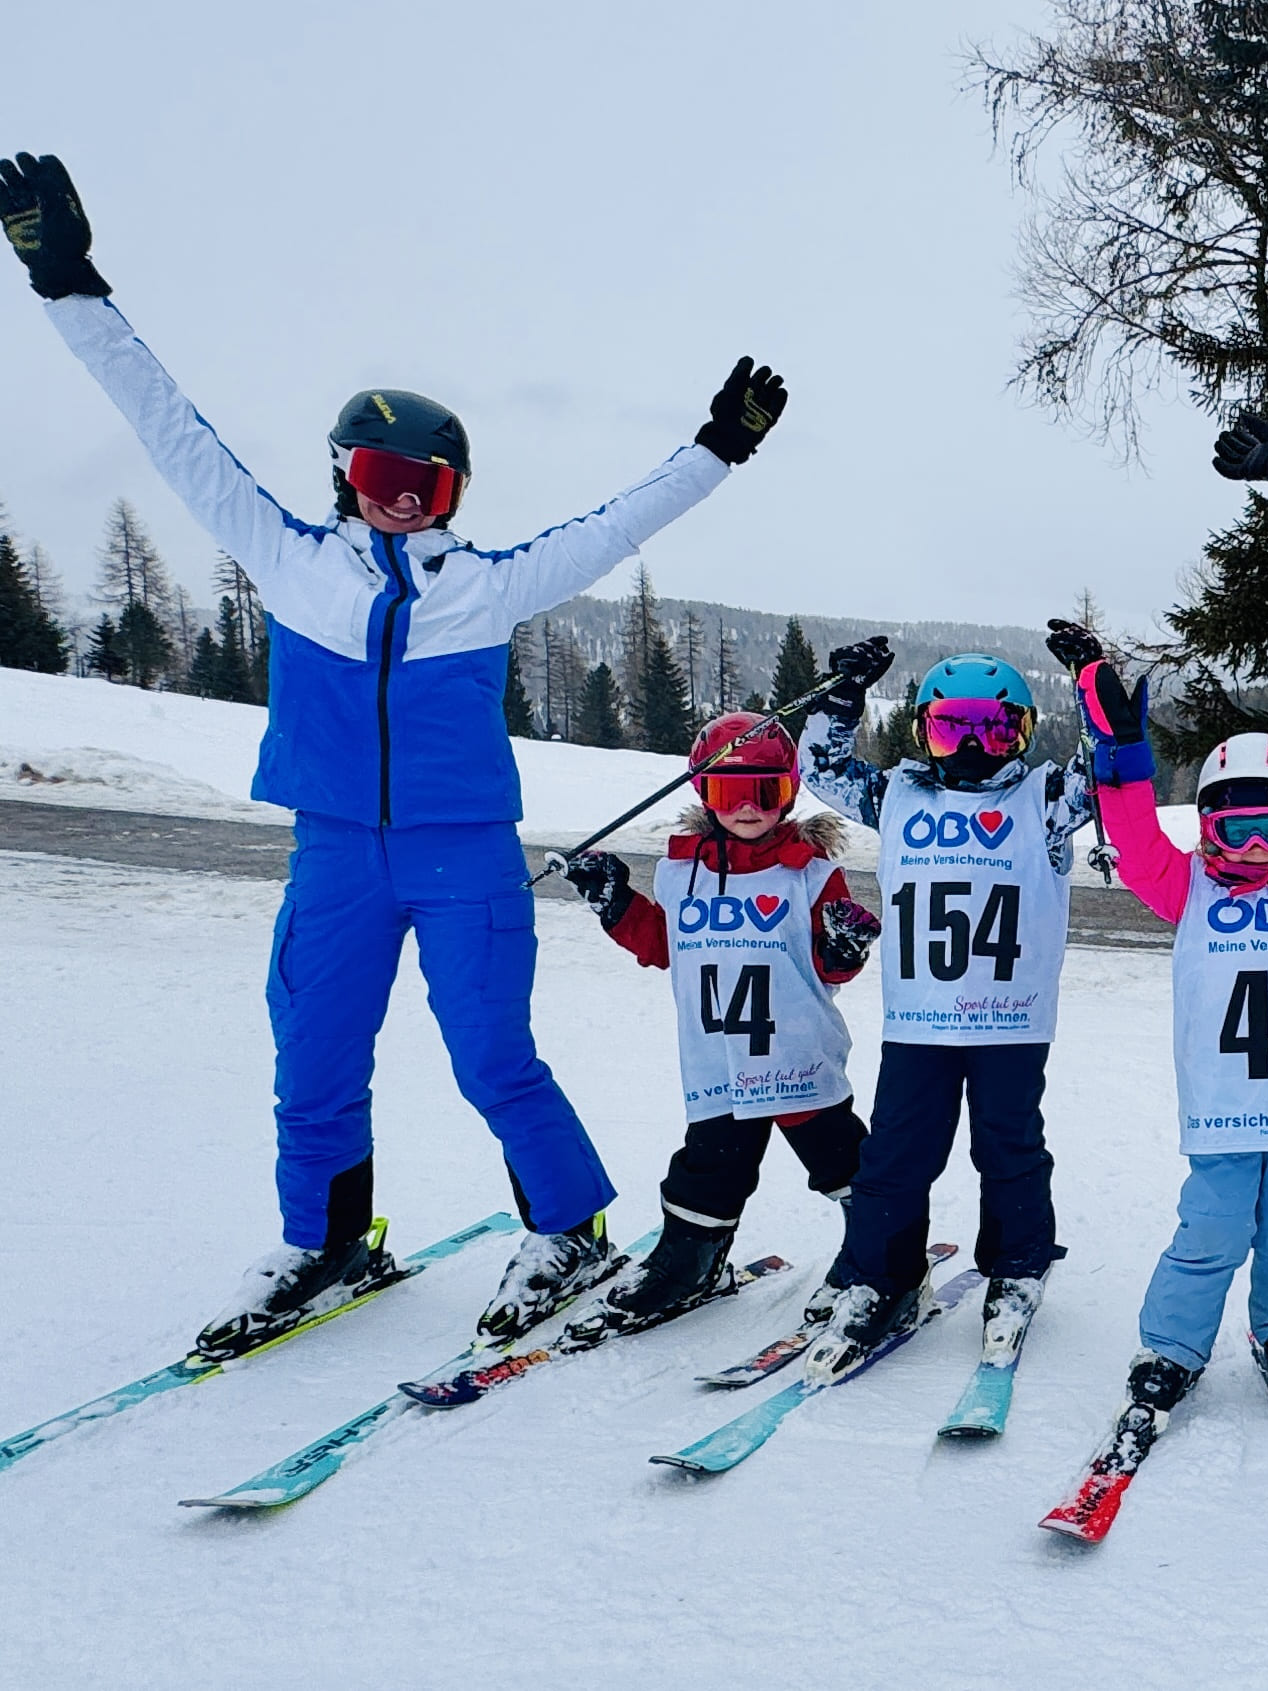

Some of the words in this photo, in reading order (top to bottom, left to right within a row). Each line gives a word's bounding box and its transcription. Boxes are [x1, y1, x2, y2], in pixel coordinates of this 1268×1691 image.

[900, 854, 931, 867] Meine
[934, 854, 1013, 871] Versicherung
[891, 882, 1022, 982] 154
[677, 939, 703, 952] Meine
[705, 937, 787, 952] Versicherung
[1208, 939, 1247, 954] Meine
[953, 995, 989, 1015] Sport
[990, 995, 1009, 1011] tut
[900, 1009, 962, 1023] versichern
[968, 1010, 989, 1023] wir
[992, 1010, 1031, 1023] Ihnen.
[750, 1083, 771, 1096] wir
